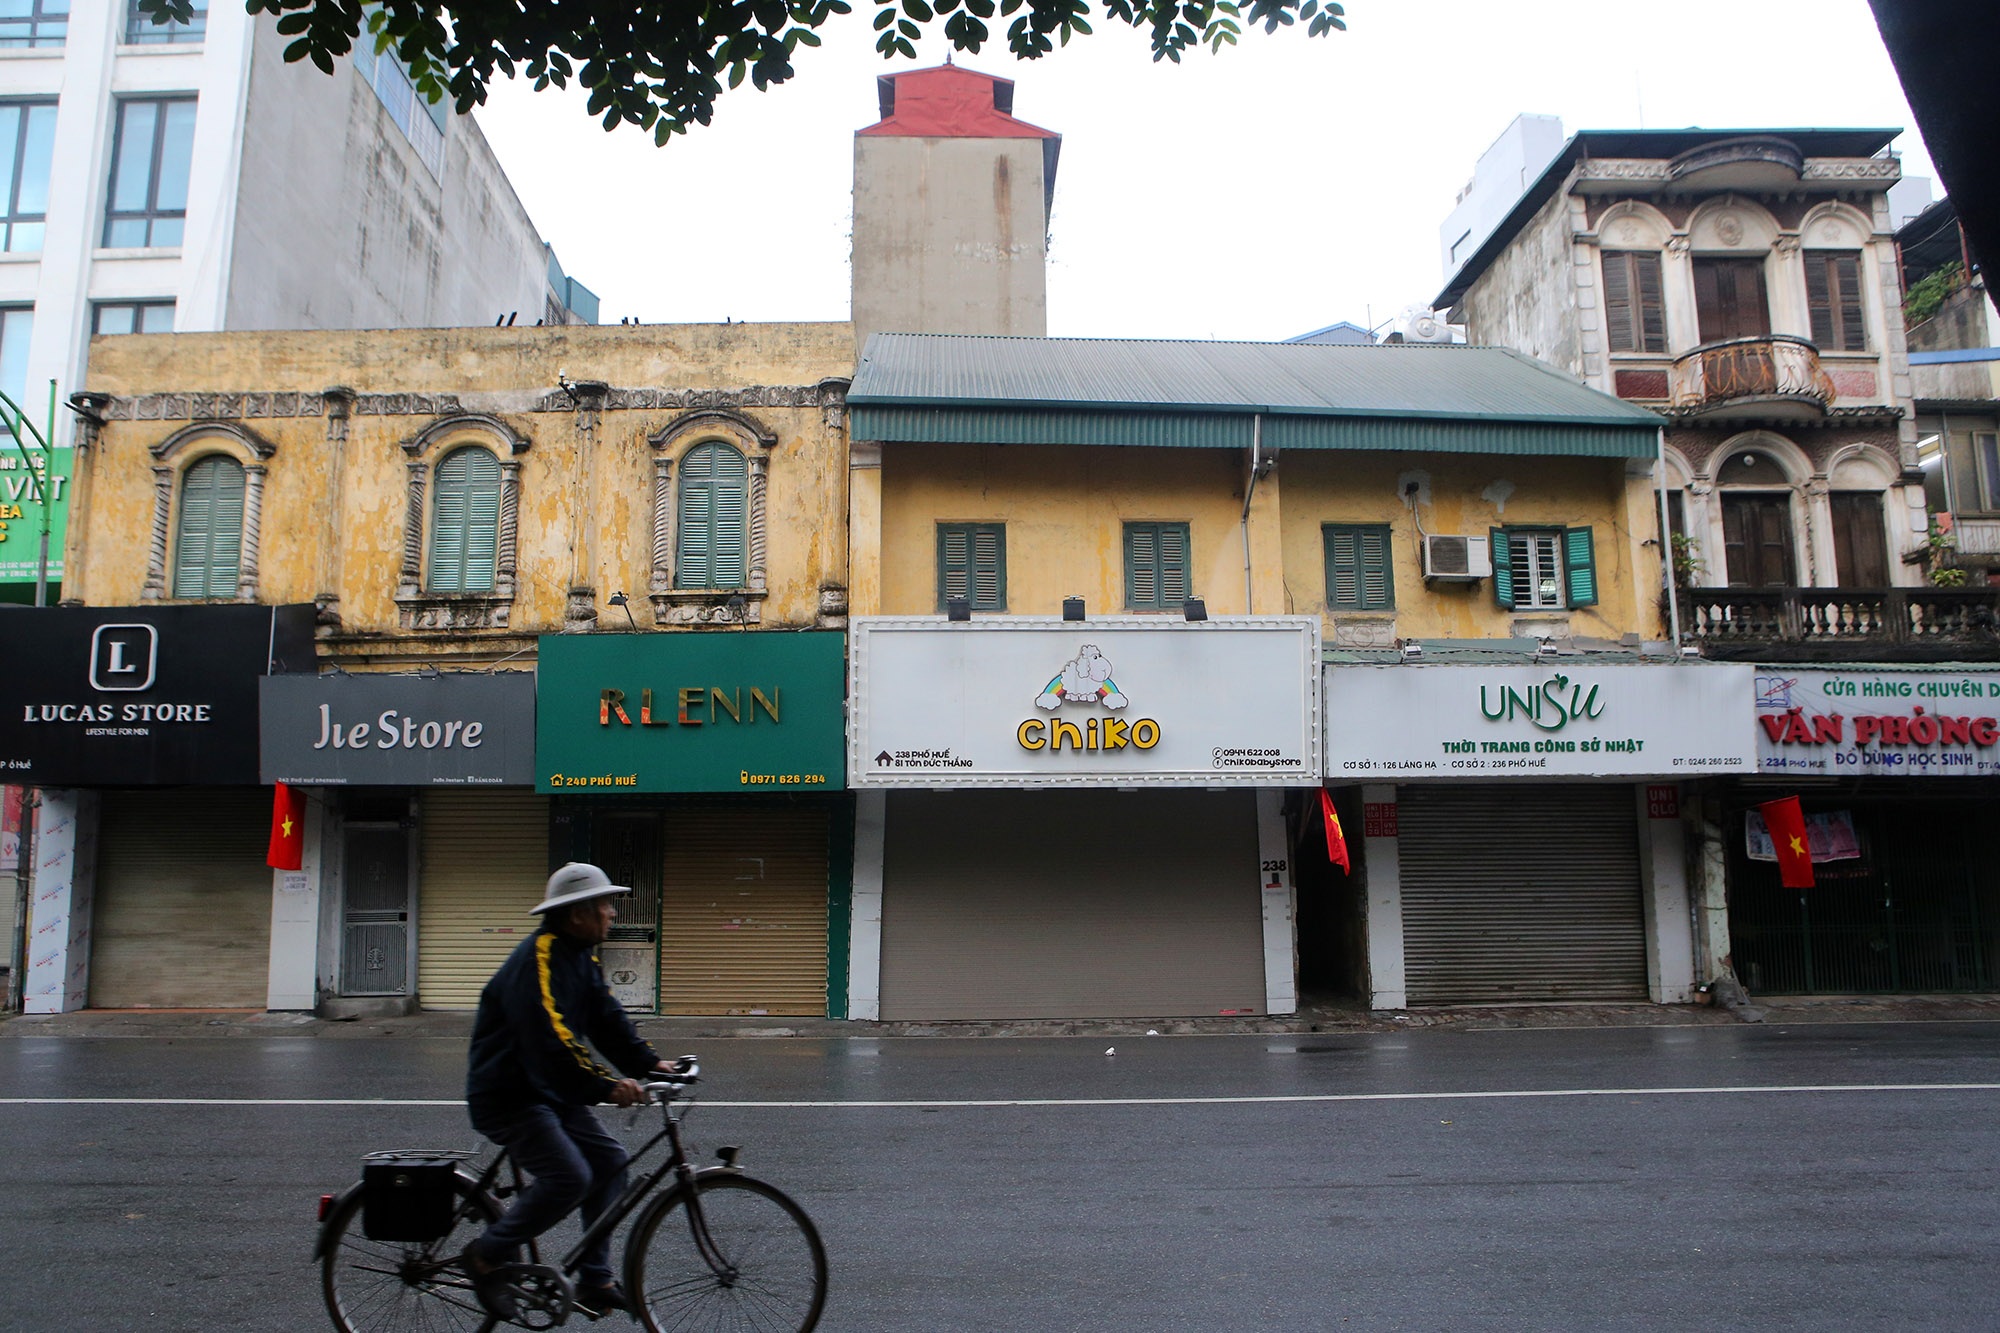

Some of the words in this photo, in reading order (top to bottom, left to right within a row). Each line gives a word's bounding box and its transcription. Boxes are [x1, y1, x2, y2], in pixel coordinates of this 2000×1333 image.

[107, 641, 136, 673] L
[1823, 677, 1856, 695] CỬA
[1862, 678, 1912, 697] HÀNG
[1917, 679, 1983, 697] CHUYÊN
[24, 704, 114, 722] LUCAS
[122, 703, 211, 722] STORE
[600, 687, 780, 725] RLENN
[86, 727, 118, 736] LIFESTYLE
[118, 727, 132, 736] FOR
[133, 727, 149, 736] MEN
[377, 709, 483, 749] Store
[1759, 706, 1844, 744] VĂN
[1853, 706, 2000, 746] PHÒNG
[1442, 740, 1476, 753] THỜI
[1481, 741, 1530, 753] TRANG
[1534, 739, 1576, 753] CÔNG
[1580, 737, 1601, 753] SỞ
[1605, 739, 1644, 753] NHẬT
[895, 750, 911, 759] 238
[911, 748, 931, 759] PHỐ
[931, 747, 951, 759] HUẾ
[1223, 748, 1246, 756] 0944
[1246, 748, 1263, 756] 622
[1263, 748, 1281, 756] 008
[1766, 758, 1787, 767] 234
[1789, 757, 1807, 768] PHỐ
[1808, 758, 1827, 768] HUẾ
[1835, 747, 1858, 765] ĐỒ
[1863, 749, 1903, 765] DÙNG
[1909, 753, 1937, 769] HỌC
[1941, 753, 1973, 766] SINH
[923, 758, 942, 767] ĐỨC
[942, 756, 973, 767] THẮNG
[1343, 761, 1357, 769] CƠ
[1358, 759, 1372, 769] SỞ
[1382, 760, 1397, 769] 126
[1398, 759, 1423, 769] LÁNG
[1424, 760, 1438, 770] HẠ
[1451, 760, 1465, 768] CƠ
[1466, 758, 1480, 768] SỞ
[1492, 760, 1507, 768] 236
[1508, 758, 1527, 768] PHỐ
[1528, 757, 1546, 768] HUẾ
[567, 777, 587, 786] 240
[590, 774, 612, 786] PHỐ
[615, 773, 637, 786] HUẾ
[750, 775, 776, 784] 0971
[780, 775, 800, 784] 626
[804, 774, 826, 784] 294
[1650, 789, 1673, 801] UNI
[1262, 859, 1286, 872] 238
